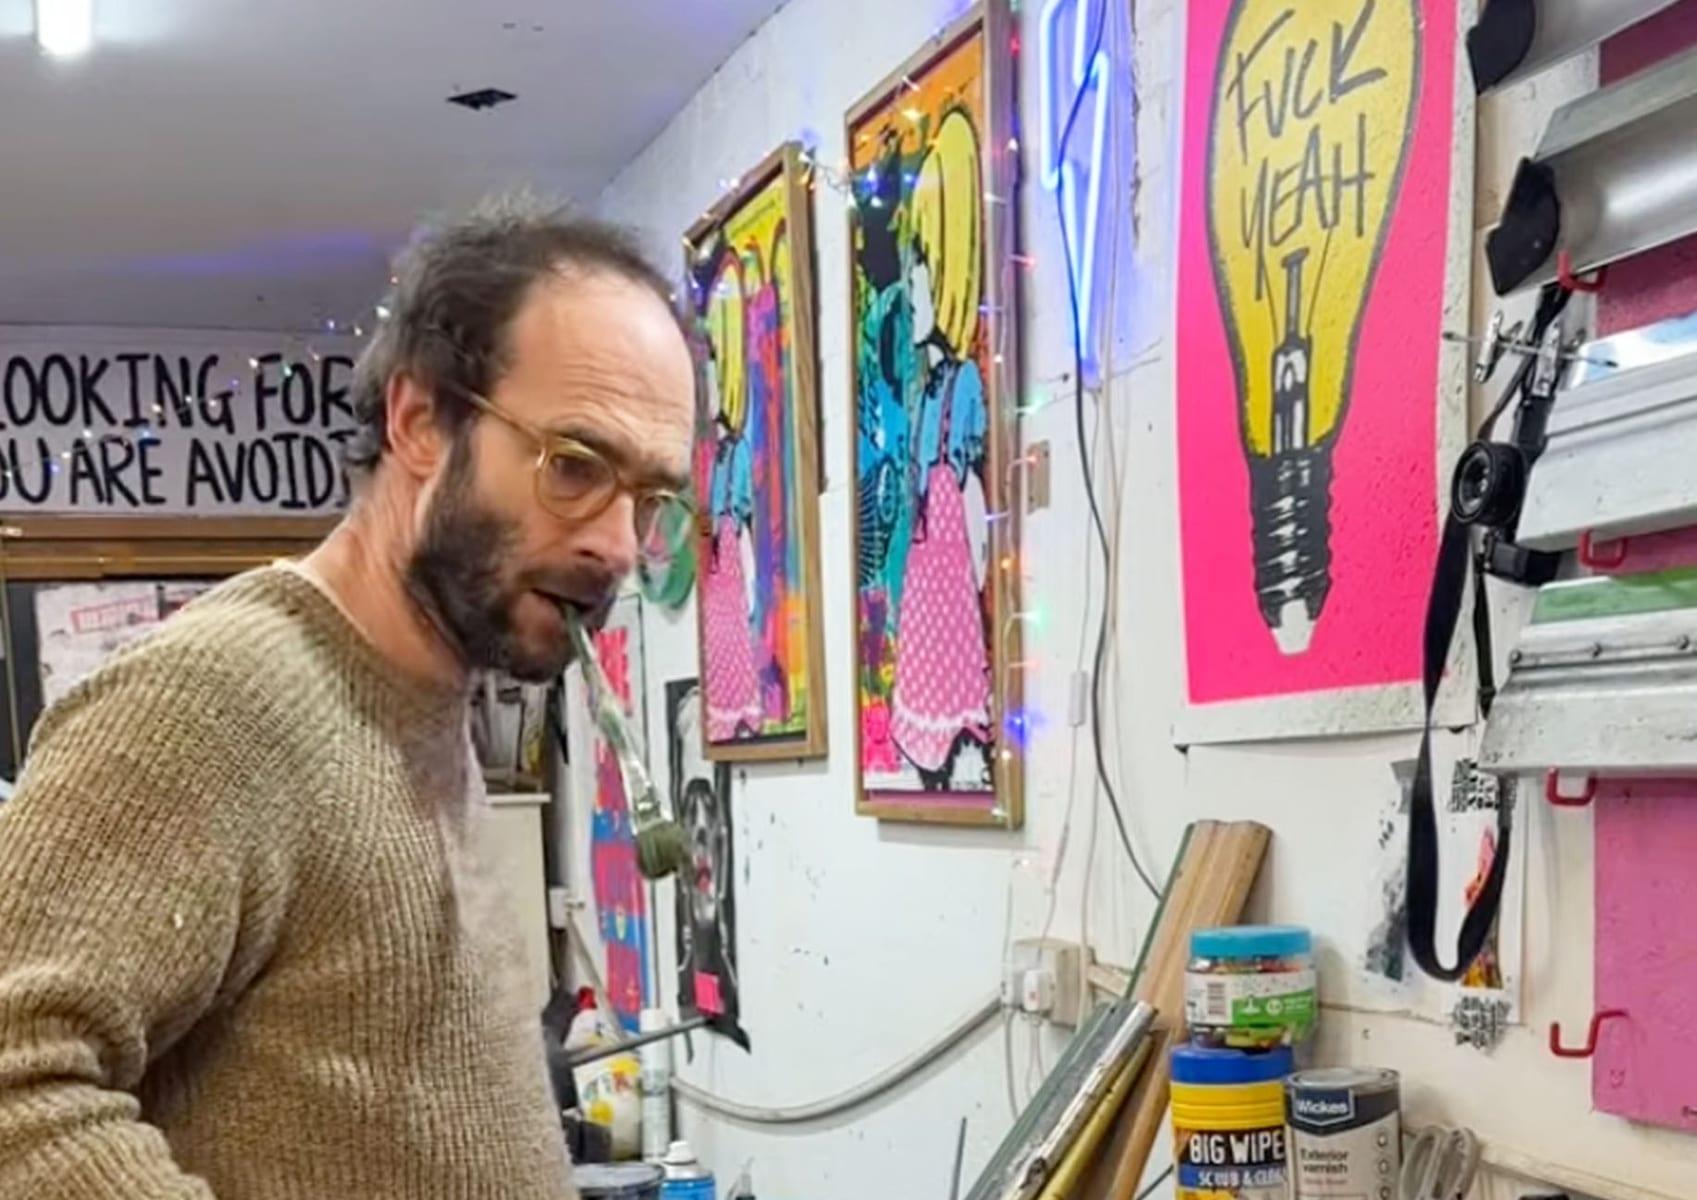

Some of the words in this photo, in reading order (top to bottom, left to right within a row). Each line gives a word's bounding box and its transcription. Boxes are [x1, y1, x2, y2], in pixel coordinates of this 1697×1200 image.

[1226, 0, 1388, 166] FUCK
[1241, 113, 1376, 301] YEAH
[0, 354, 236, 434] OOKING
[255, 353, 355, 430] FOR
[70, 434, 167, 507] ARE
[1297, 1100, 1349, 1114] Wickes
[1189, 1133, 1226, 1165] BIG
[1303, 1162, 1348, 1174] varnish
